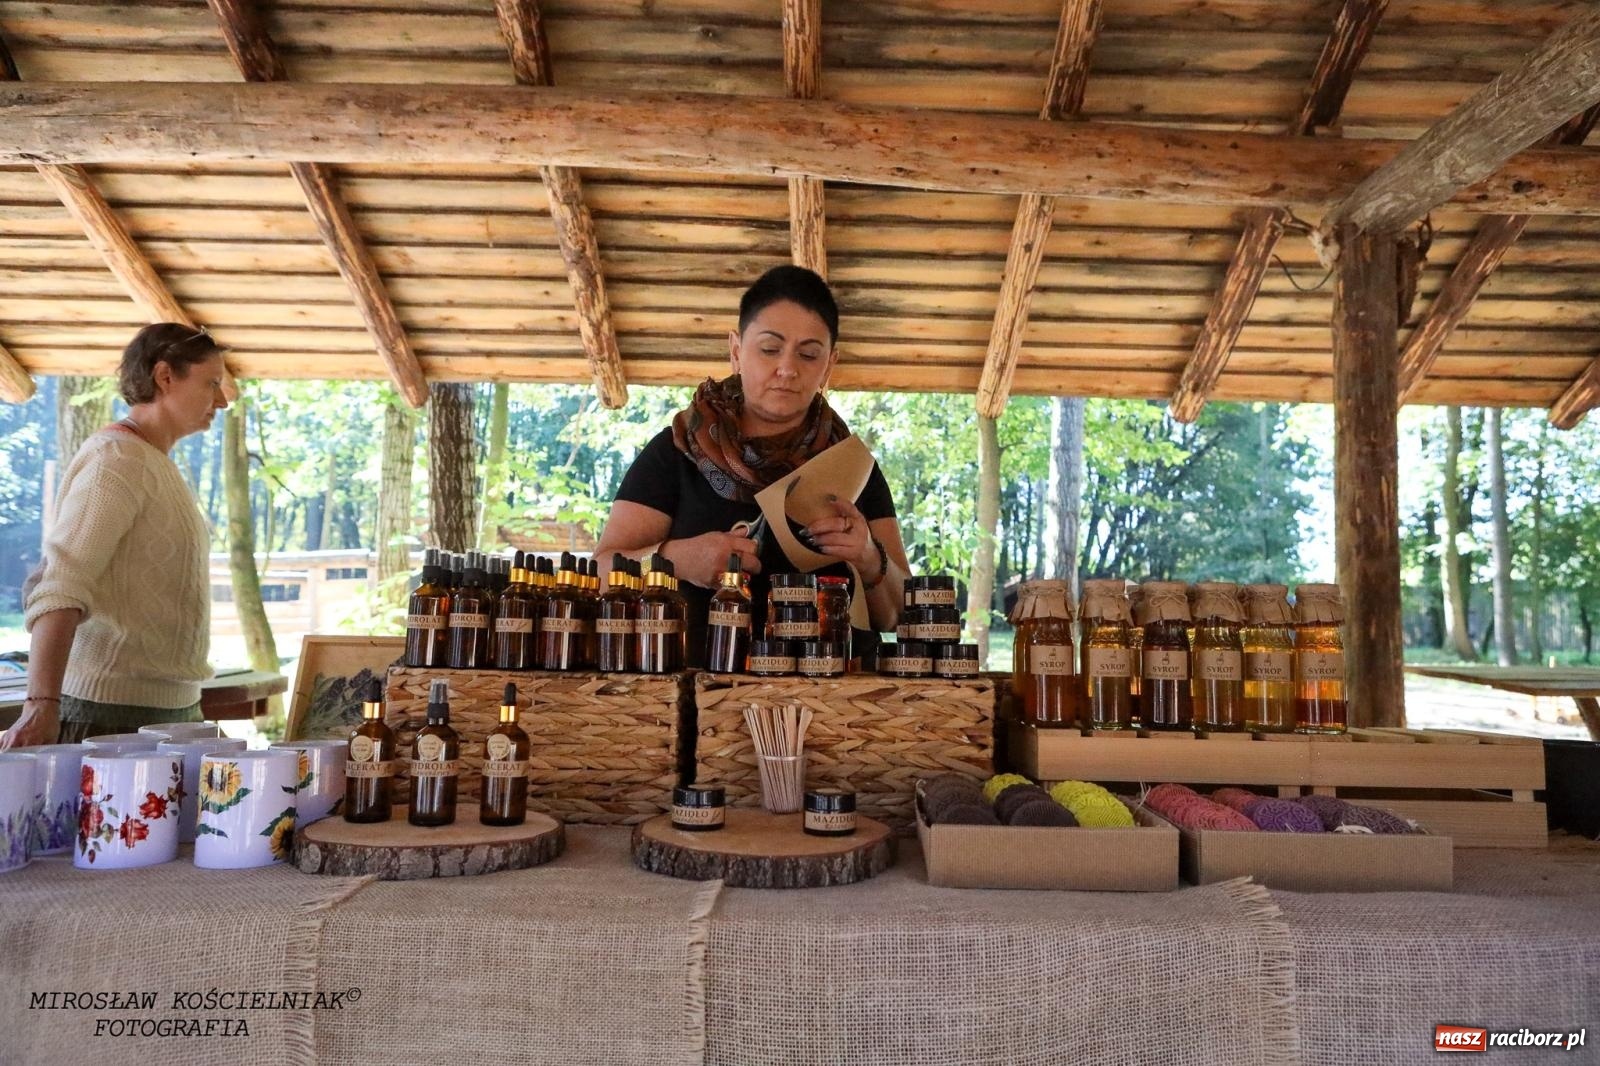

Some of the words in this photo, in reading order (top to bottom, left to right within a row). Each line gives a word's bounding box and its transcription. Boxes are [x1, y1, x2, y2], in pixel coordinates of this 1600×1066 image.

[1039, 661, 1066, 669] SYROP
[1100, 663, 1126, 671] SYROP
[1152, 665, 1180, 673] SYROP
[1206, 665, 1234, 673] SYROP
[1254, 667, 1282, 675] SYROP
[1308, 667, 1337, 675] SYROP
